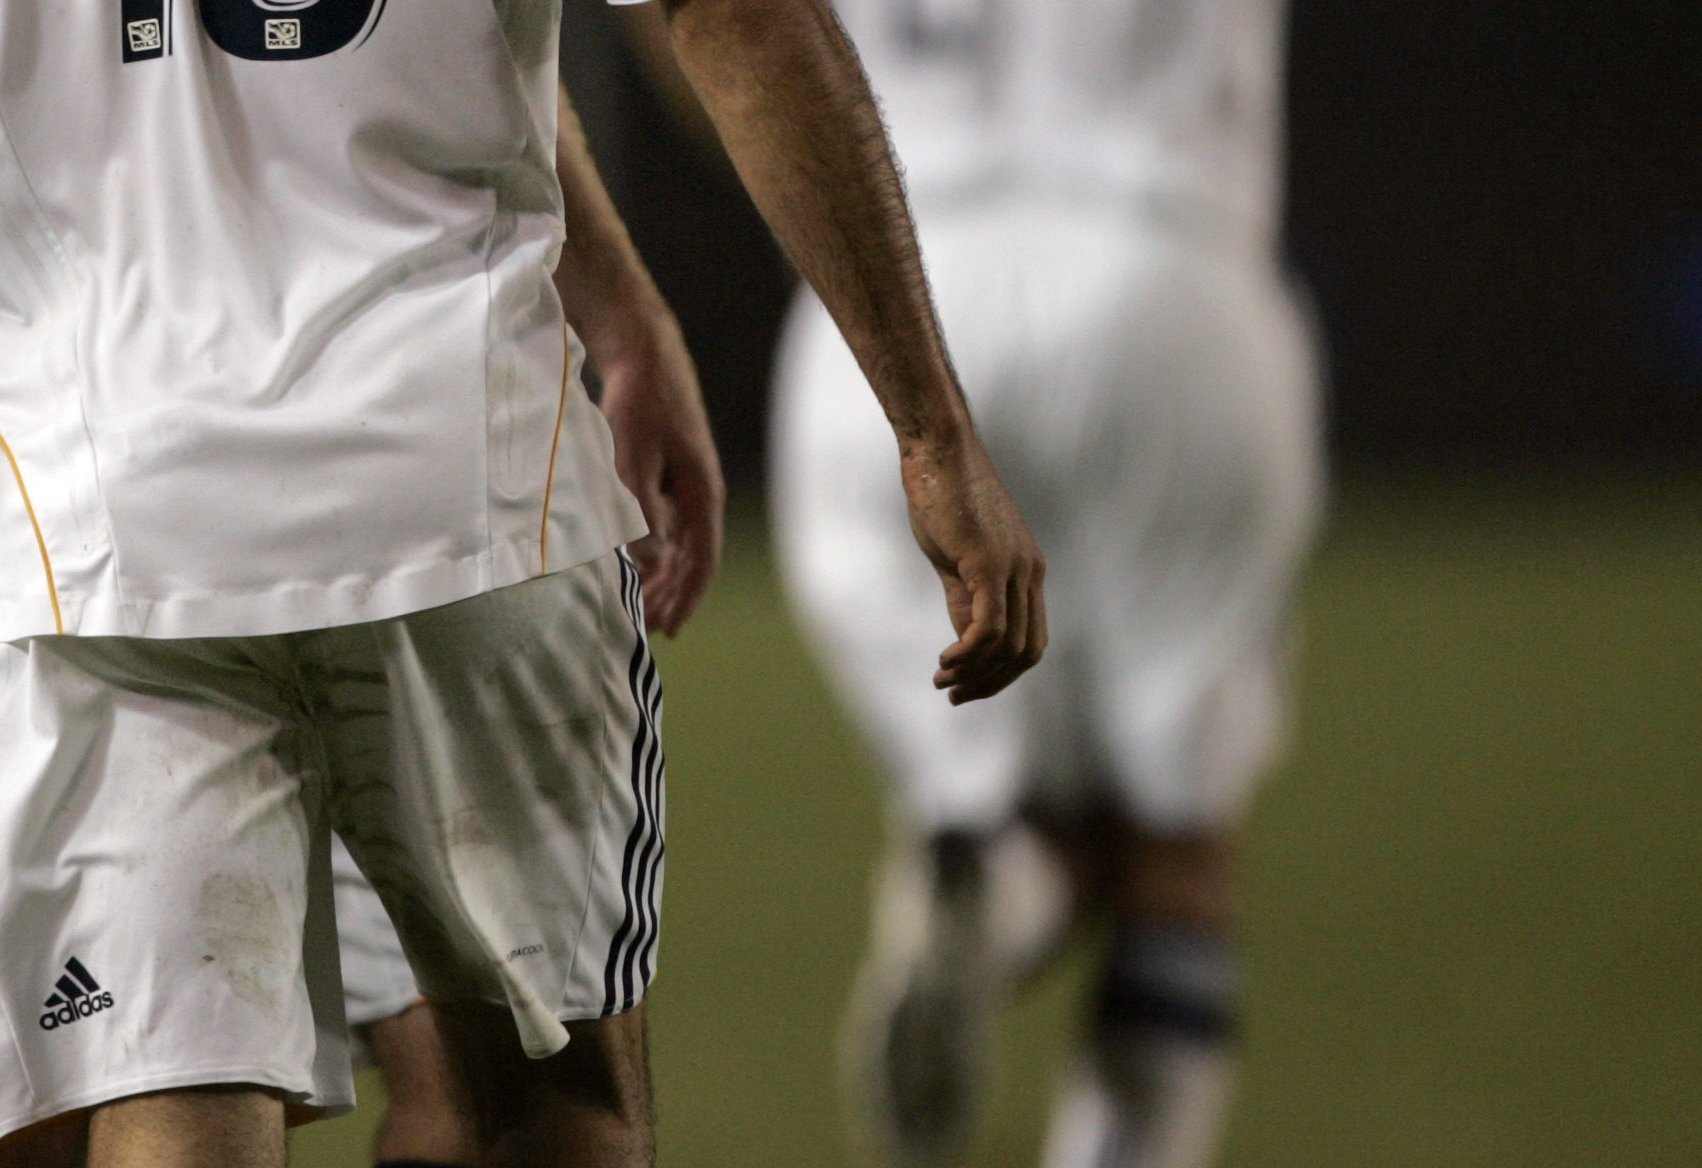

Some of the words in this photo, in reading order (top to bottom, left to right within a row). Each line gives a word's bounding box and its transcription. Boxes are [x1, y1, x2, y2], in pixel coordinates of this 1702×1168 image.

[133, 39, 159, 48] MLS
[267, 39, 299, 47] MLS
[39, 990, 115, 1031] adidas
